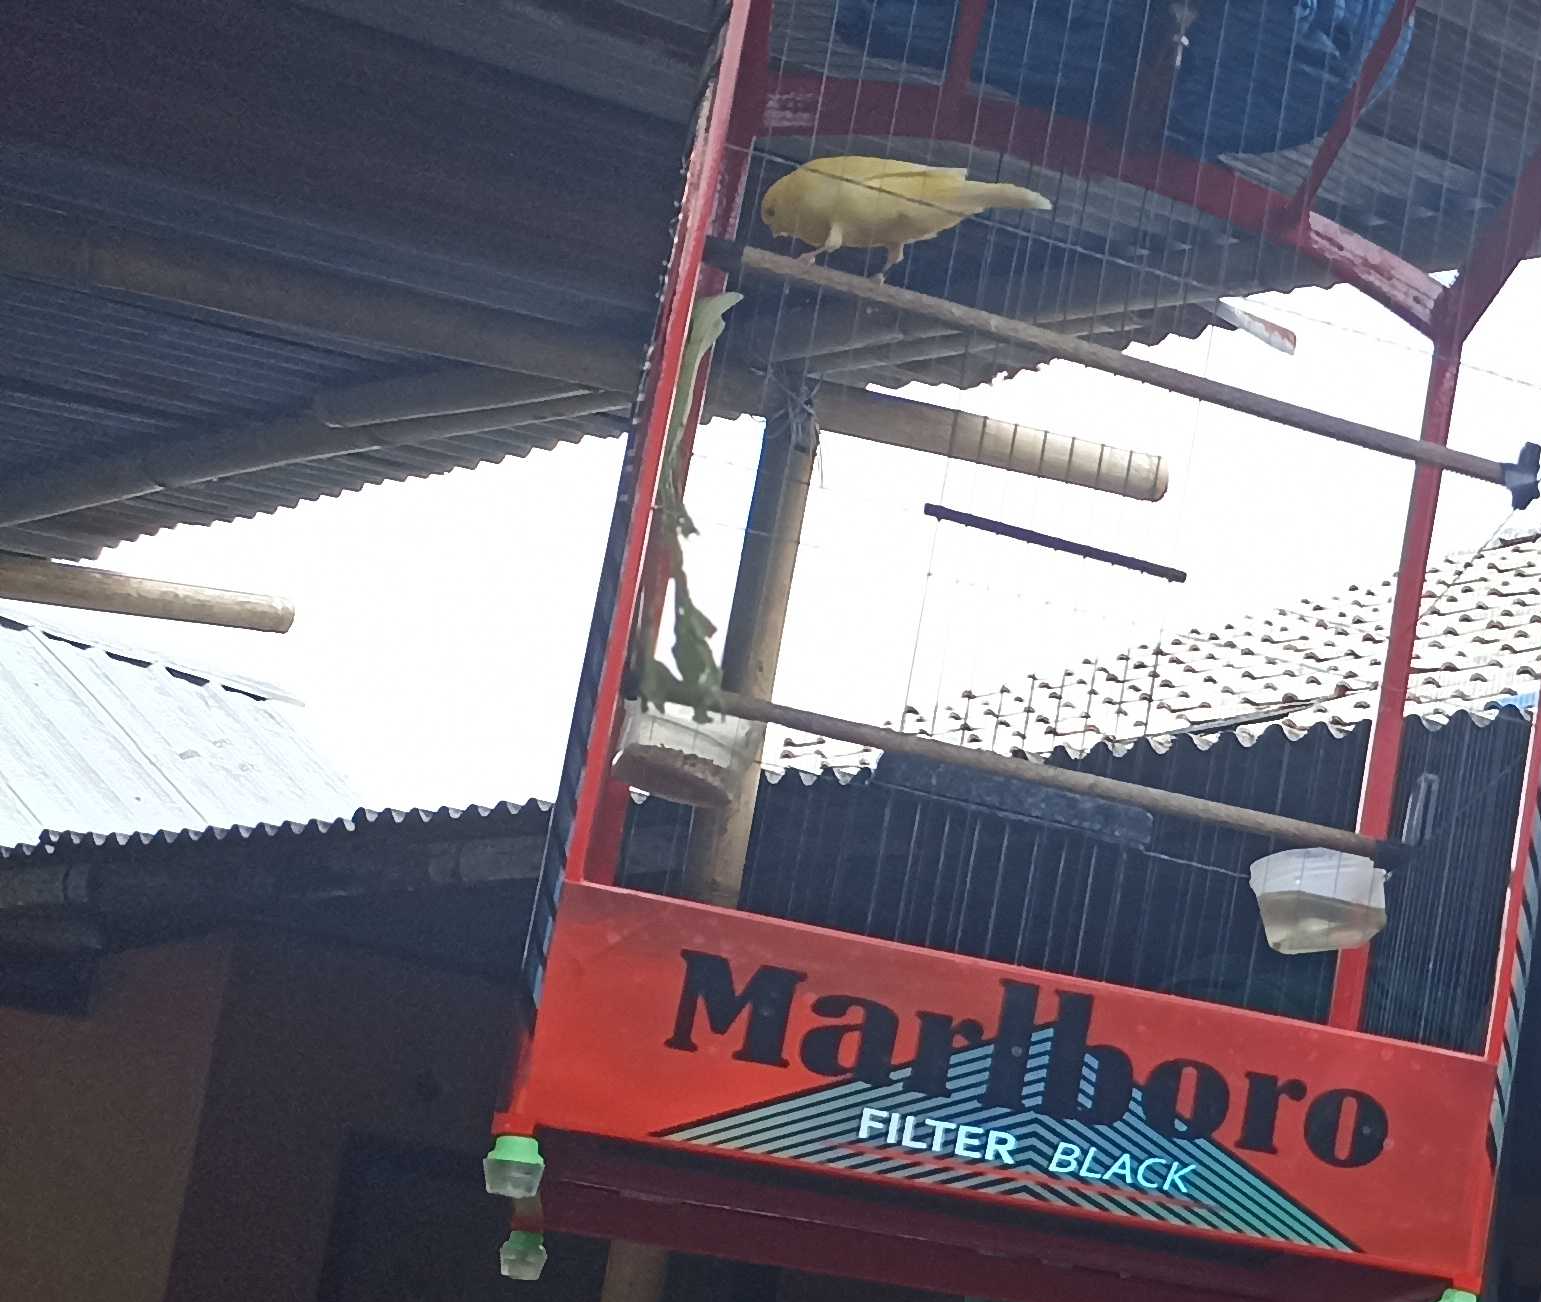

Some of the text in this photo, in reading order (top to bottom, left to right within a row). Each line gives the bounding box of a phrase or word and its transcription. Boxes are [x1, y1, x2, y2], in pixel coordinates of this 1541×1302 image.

[663, 948, 1390, 1169] Marlboro
[857, 1106, 1198, 1194] FILTER BLACK
